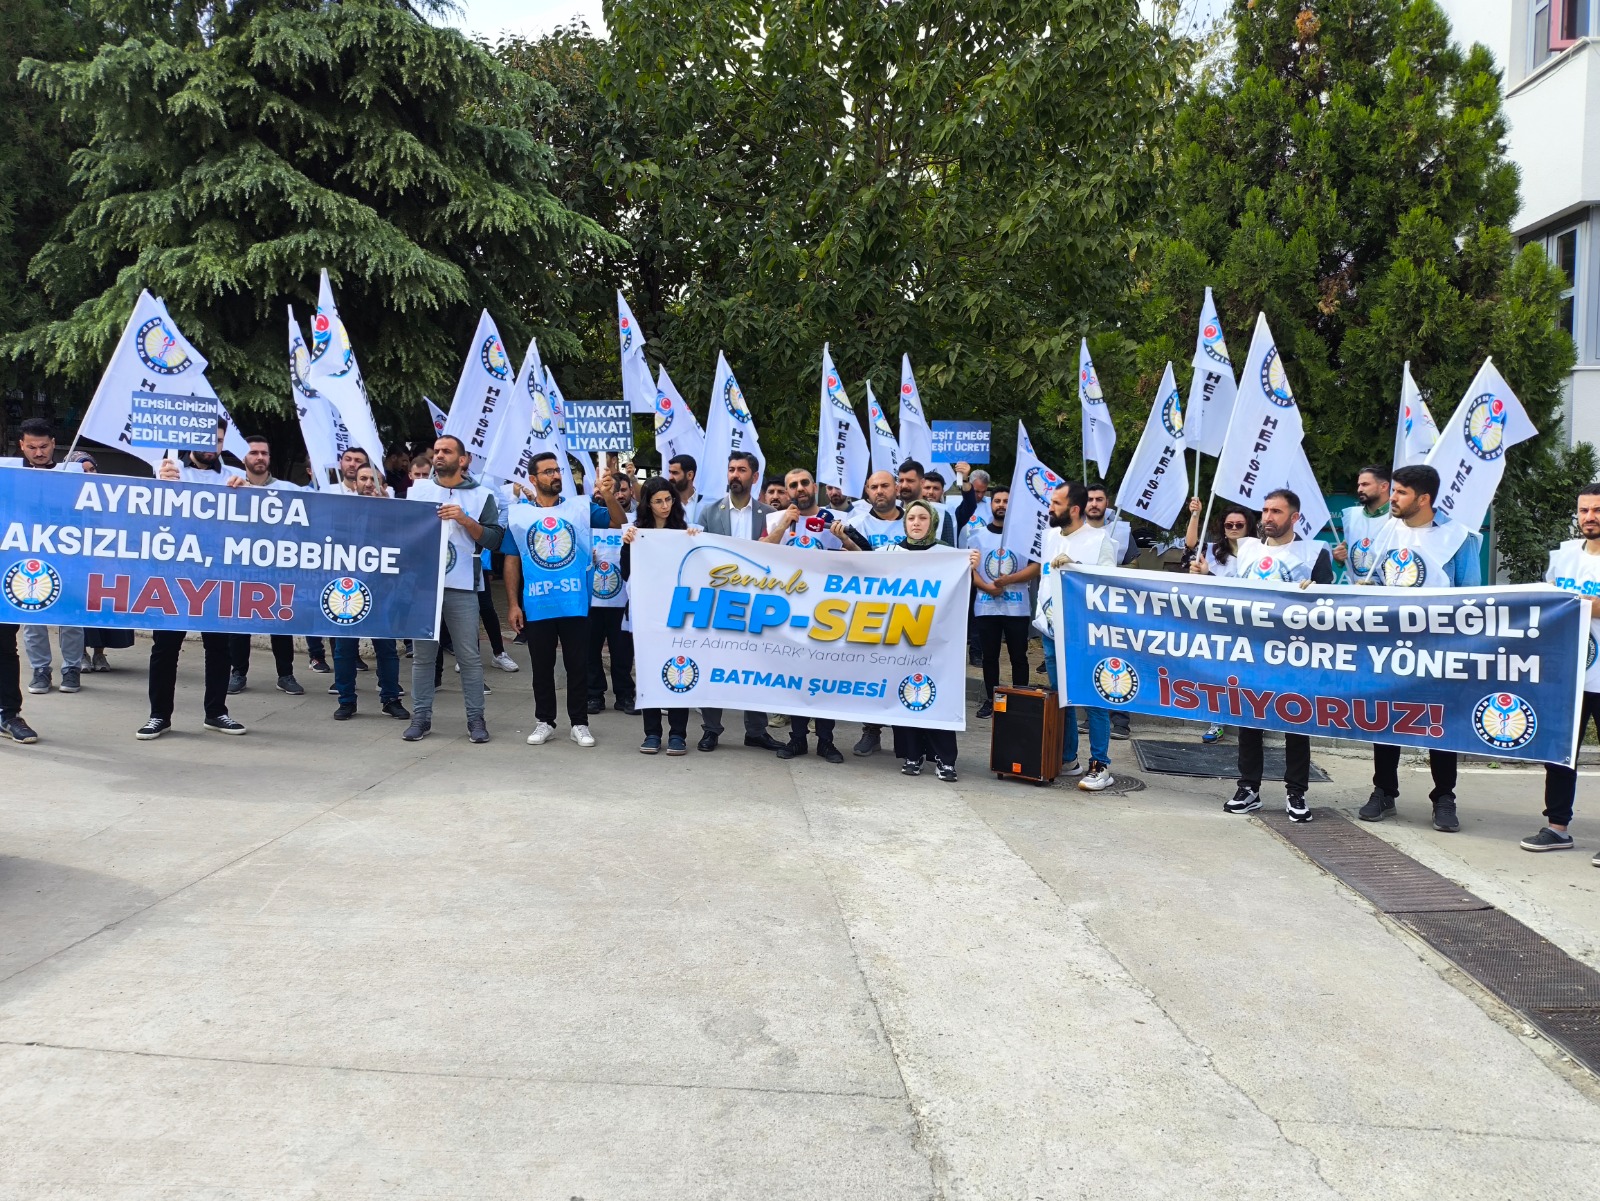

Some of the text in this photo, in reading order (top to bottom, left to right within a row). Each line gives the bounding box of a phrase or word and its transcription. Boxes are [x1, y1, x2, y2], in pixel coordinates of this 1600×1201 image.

[132, 412, 177, 426] HAKKI
[179, 416, 217, 429] GASP
[133, 397, 217, 414] TEMSİLCİMİZİN
[471, 386, 500, 448] HEP-SEN
[565, 403, 630, 418] LİYAKAT!
[132, 426, 217, 446] EDİLEMEZ!
[566, 418, 631, 434] LİYAKAT!
[932, 429, 990, 442] EŞİT EMEĞE
[567, 434, 632, 450] LİYAKAT!
[931, 440, 990, 453] EŞİT ÜCRET!
[1239, 415, 1279, 499] HEP-SEN
[1135, 445, 1175, 511] HEP-SEN
[74, 481, 310, 527] AYRIMCILIĞA
[0, 522, 213, 568] AKSIZLIĞA,
[224, 535, 401, 574] MOBBİNGE
[593, 535, 622, 546] P-SE
[86, 573, 296, 621] HAYIR!
[823, 574, 942, 598] BATMAN
[666, 586, 936, 647] HEP-SEN
[1085, 583, 1541, 639] KEYFİYETE GÖRE DEĞİL!
[672, 637, 698, 648] Her
[700, 637, 758, 652] Adımda
[807, 649, 865, 664] Yaratan
[869, 653, 933, 667] Sendika!
[1088, 622, 1255, 663] MEVZUATA
[1263, 635, 1358, 671] GÖRE
[1367, 639, 1540, 684] YÖNETİM
[709, 668, 888, 698] BATMAN ŞUBESİ
[1158, 666, 1445, 738] İSTİYORUZ!
